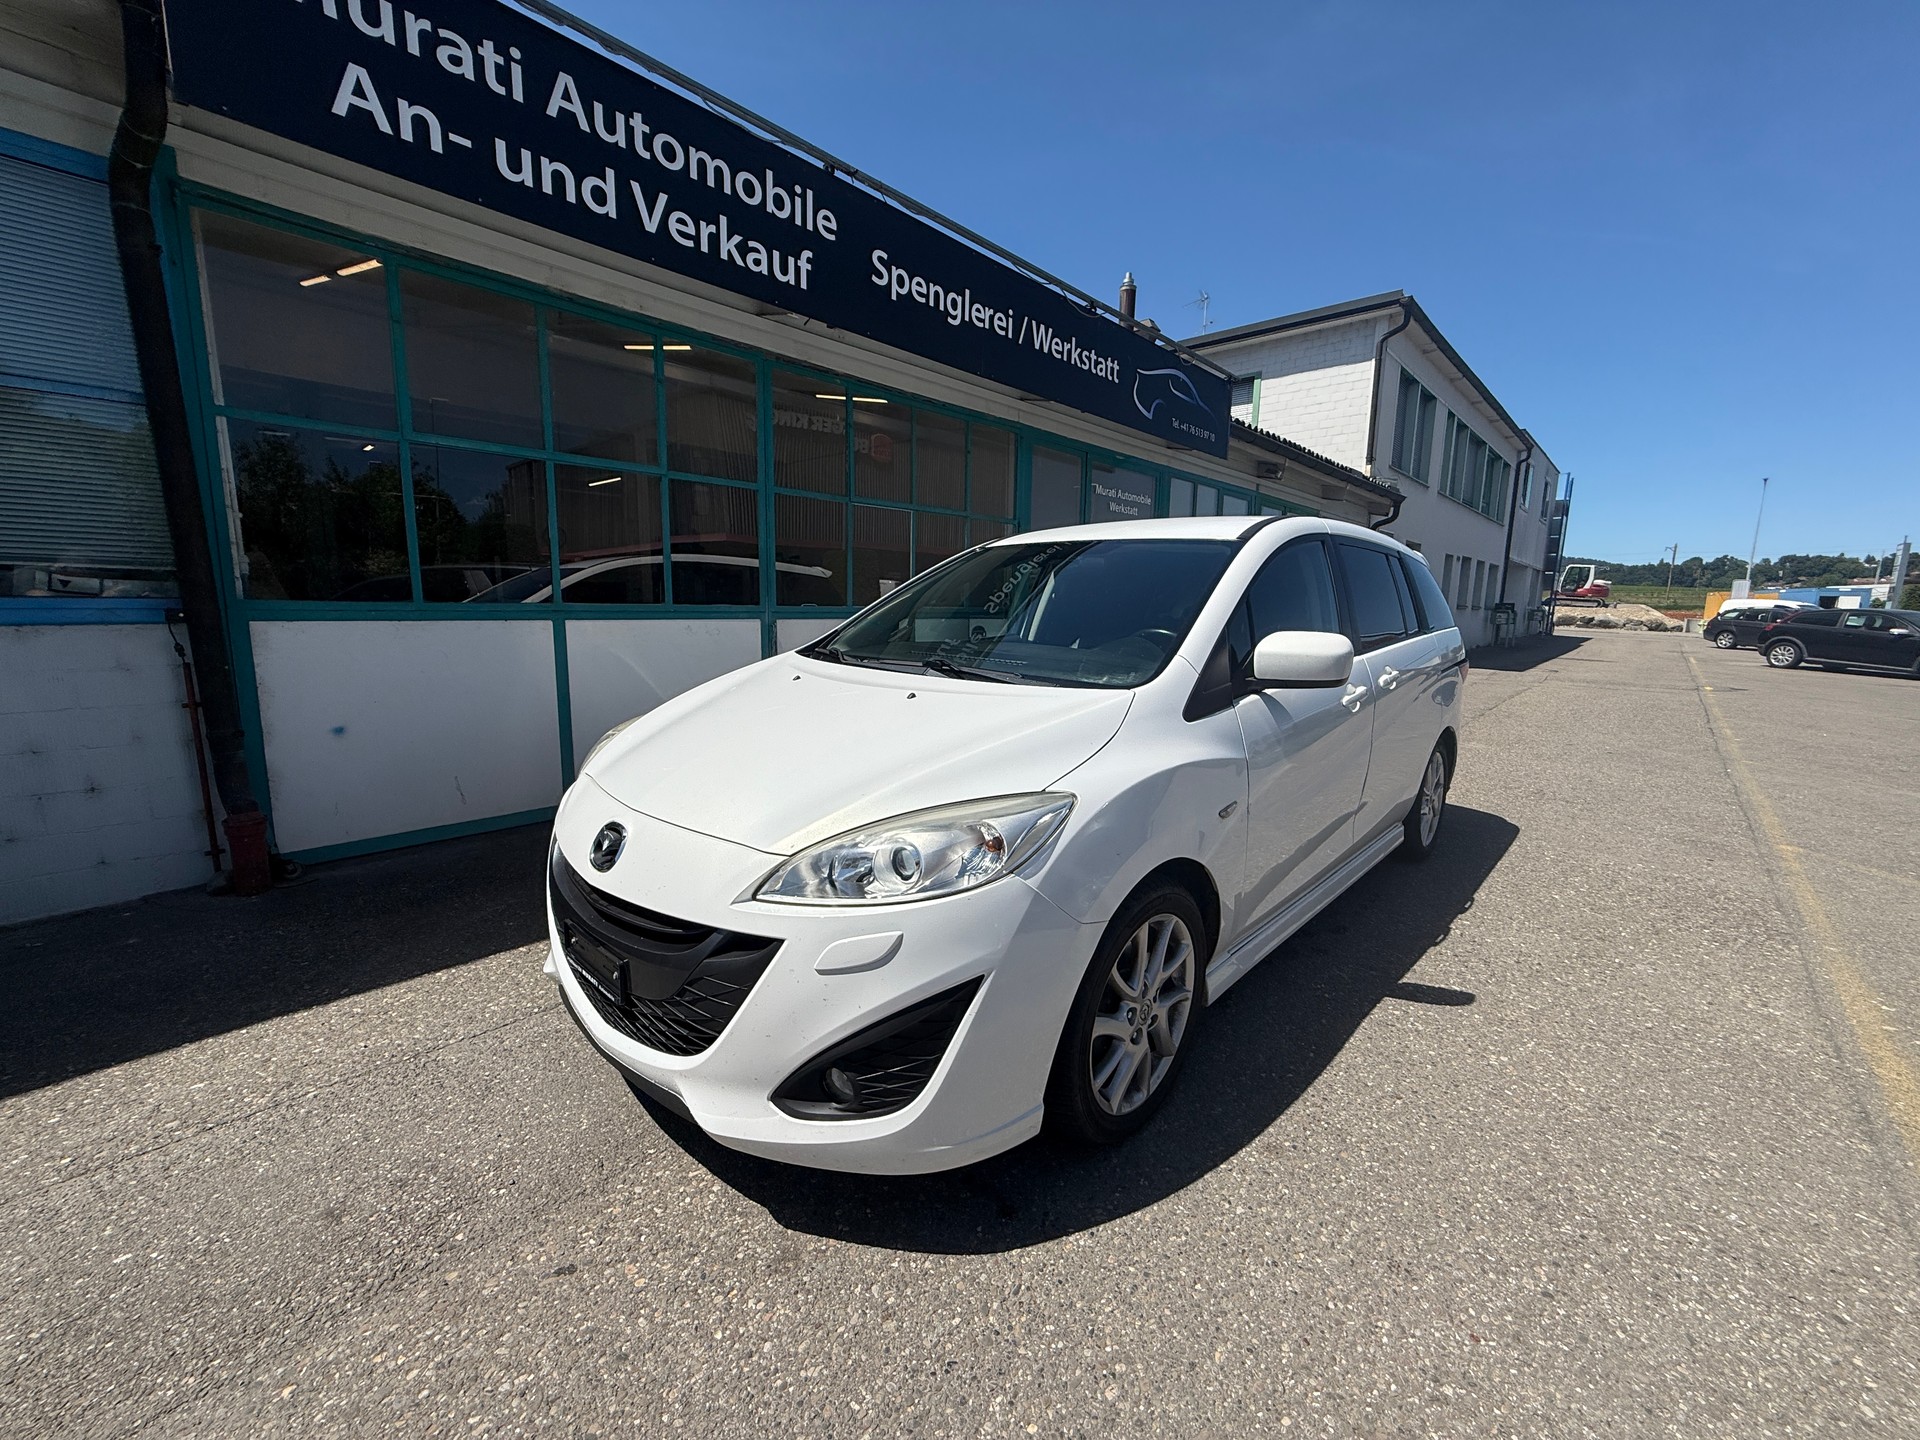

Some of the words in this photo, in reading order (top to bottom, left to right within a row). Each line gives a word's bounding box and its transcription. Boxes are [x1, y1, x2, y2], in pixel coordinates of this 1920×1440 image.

[322, 0, 524, 104] urati
[545, 71, 838, 241] Automobile
[331, 62, 472, 154] An-
[494, 137, 617, 220] und
[629, 179, 813, 290] Verkauf
[871, 249, 1013, 339] Spenglerei
[1018, 316, 1029, 345] /
[1031, 320, 1120, 384] Werkstatt
[1095, 484, 1117, 498] Murati
[1117, 489, 1152, 506] Automobile
[1109, 501, 1138, 516] Werkstatt
